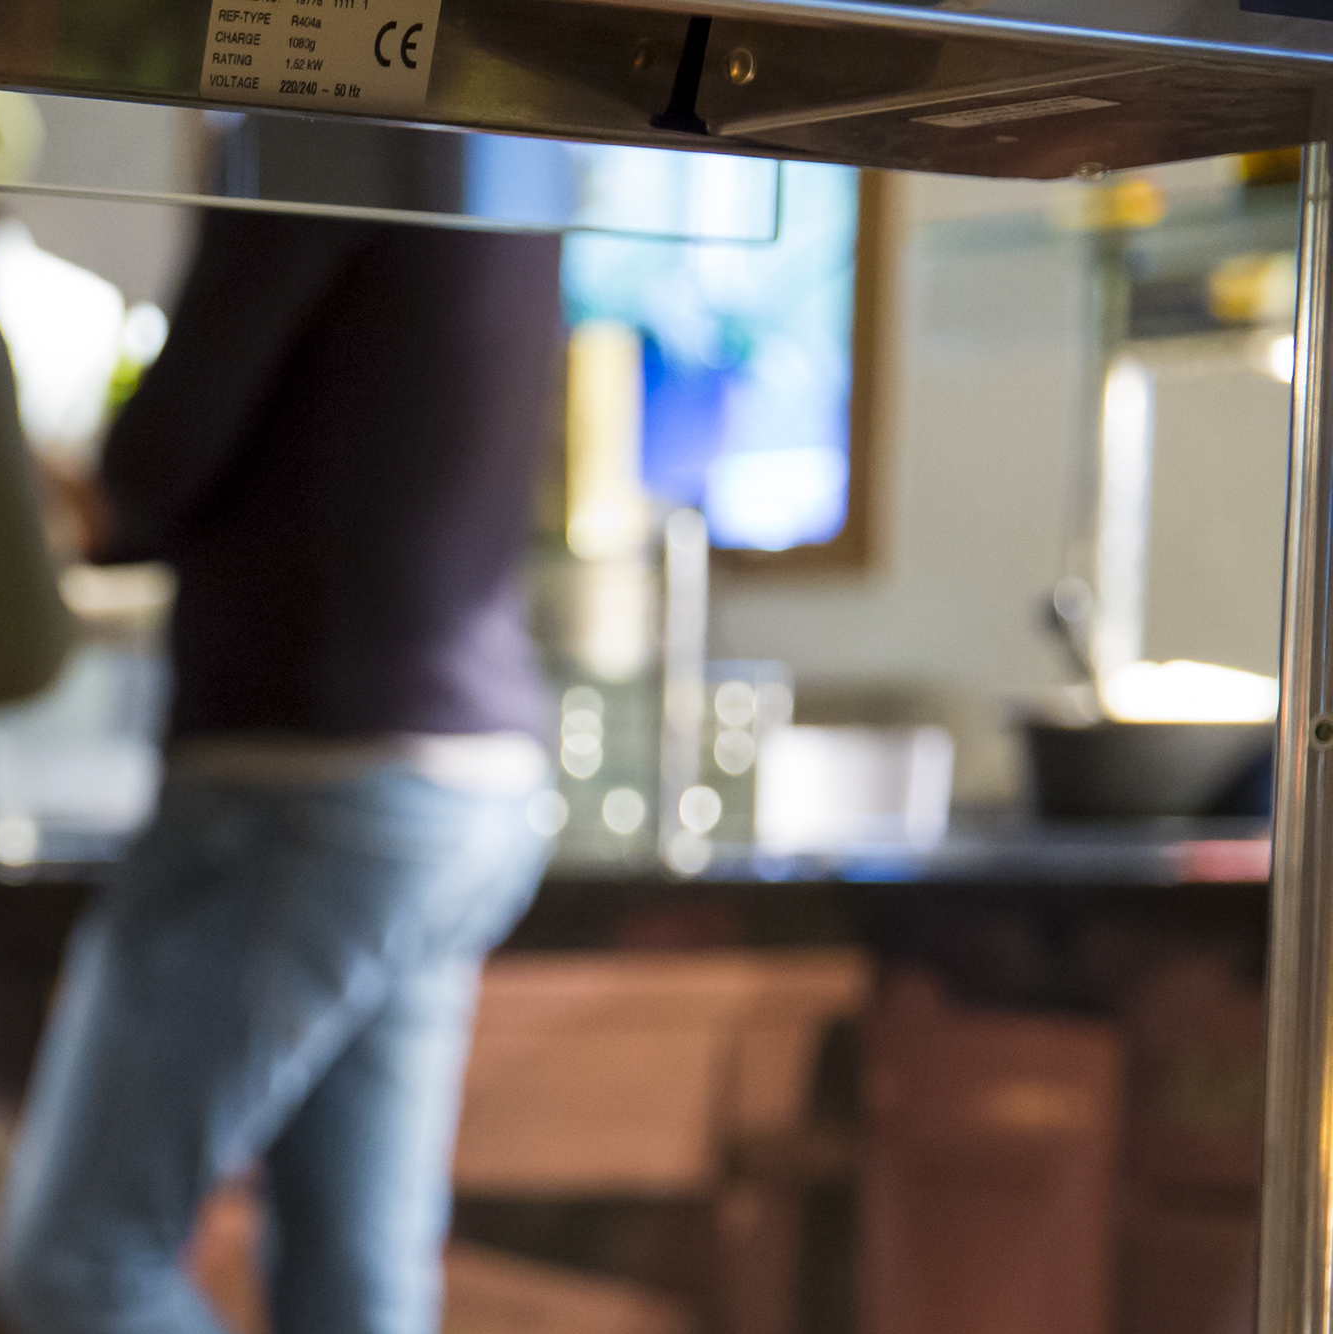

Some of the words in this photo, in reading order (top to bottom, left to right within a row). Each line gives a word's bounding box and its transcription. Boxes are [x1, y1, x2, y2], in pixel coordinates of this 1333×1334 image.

[218, 9, 272, 25] REF-TYPE
[290, 15, 322, 29] R404a
[215, 31, 262, 46] CHARGE
[374, 20, 424, 69] CE
[212, 53, 253, 67] RATING
[307, 59, 324, 71] kW
[209, 74, 260, 90] VOLTAGE
[279, 80, 318, 96] 220/240
[334, 83, 347, 97] 50
[348, 84, 361, 98] Hz
